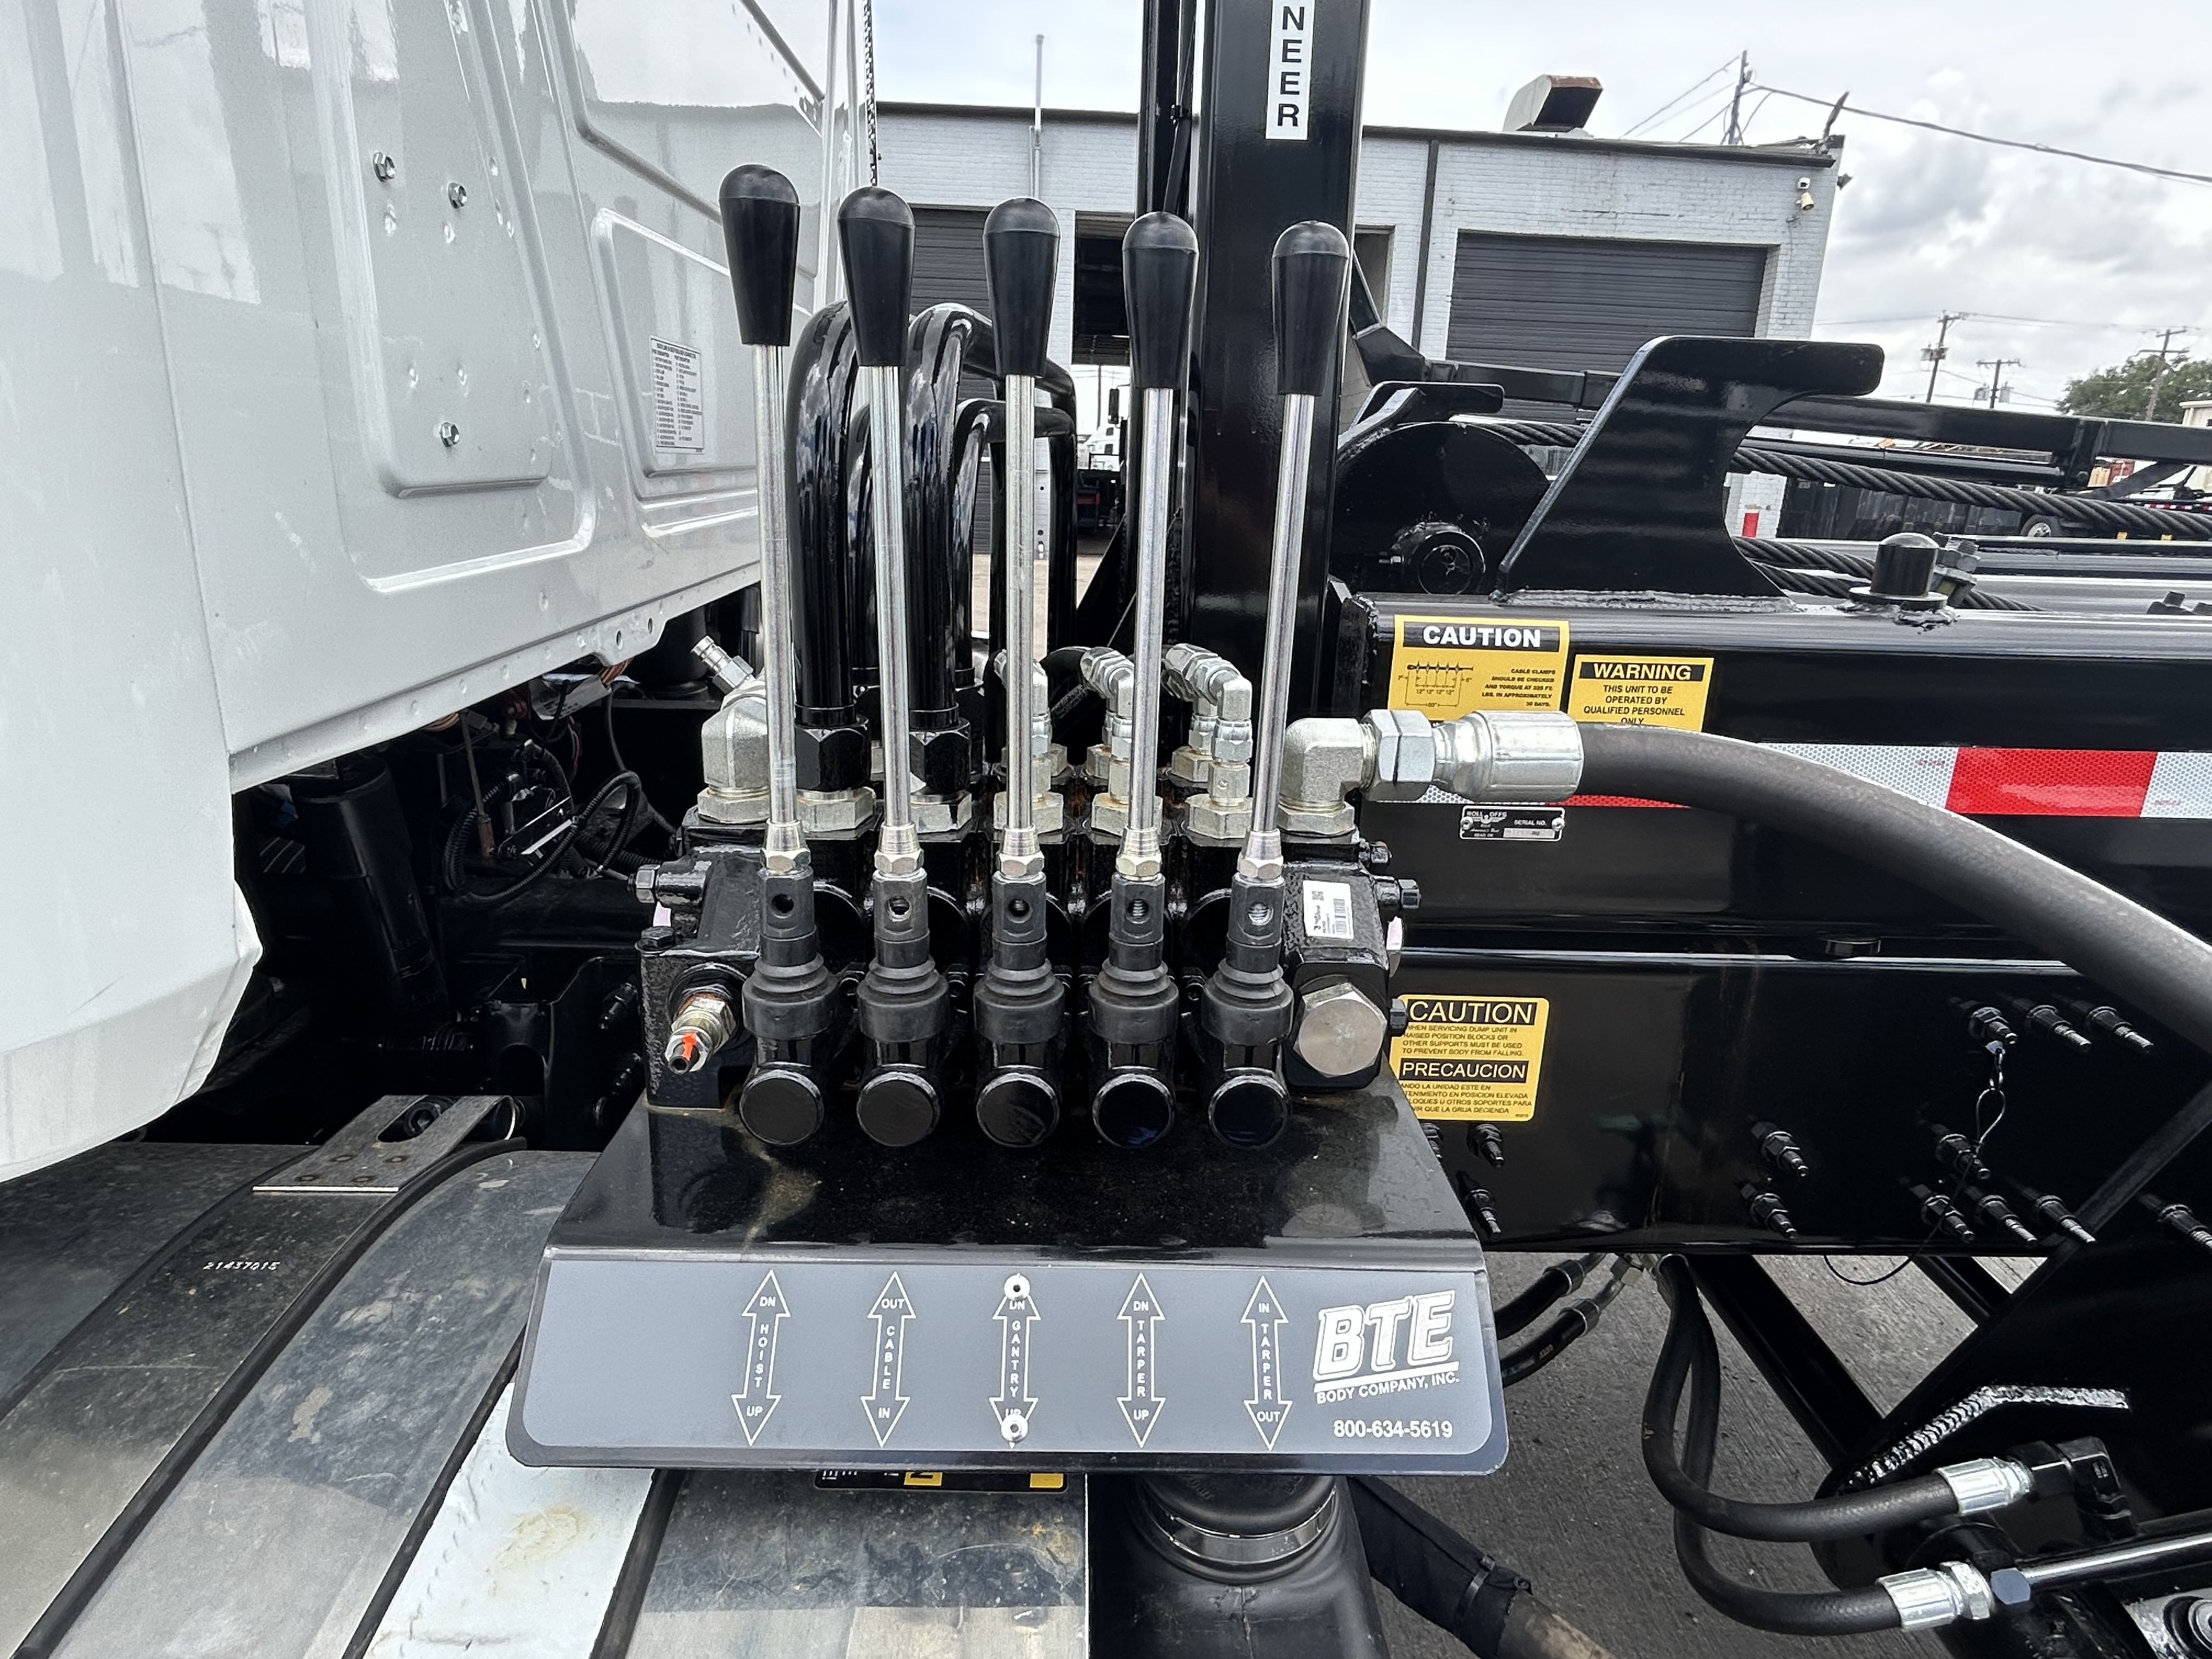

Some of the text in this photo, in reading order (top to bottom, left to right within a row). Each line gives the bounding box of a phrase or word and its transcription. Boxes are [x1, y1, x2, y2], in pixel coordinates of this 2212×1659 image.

[1277, 5, 1305, 127] NEER
[1423, 625, 1541, 648] CAUTION
[1593, 663, 1692, 680] WARNING
[1603, 685, 1673, 694] THIS UNIT TO BE
[1605, 696, 1667, 705] OPERATED BY
[1583, 706, 1685, 715] QUALIFIED PERSONNEL
[1409, 1001, 1533, 1024] CAUTION
[1402, 1062, 1526, 1079] PRECAUCION
[759, 1296, 776, 1307] DN
[881, 1298, 905, 1309] OUT
[1009, 1300, 1025, 1310] DN
[1133, 1301, 1149, 1311] DN
[1259, 1302, 1270, 1313] IN
[1313, 1289, 1455, 1381] BTE
[754, 1324, 769, 1387] HOIST
[882, 1325, 895, 1389] CABLE
[1009, 1320, 1021, 1398] GANTRY
[1136, 1320, 1146, 1397] TARPER
[1261, 1323, 1272, 1401] TARPER
[1316, 1371, 1460, 1404] BODY COMPANY, INC.
[746, 1405, 763, 1417] UP
[878, 1407, 890, 1419] IN
[1133, 1409, 1149, 1420] UP
[1256, 1410, 1281, 1423] OUT
[1333, 1419, 1453, 1438] 800-634-5619
